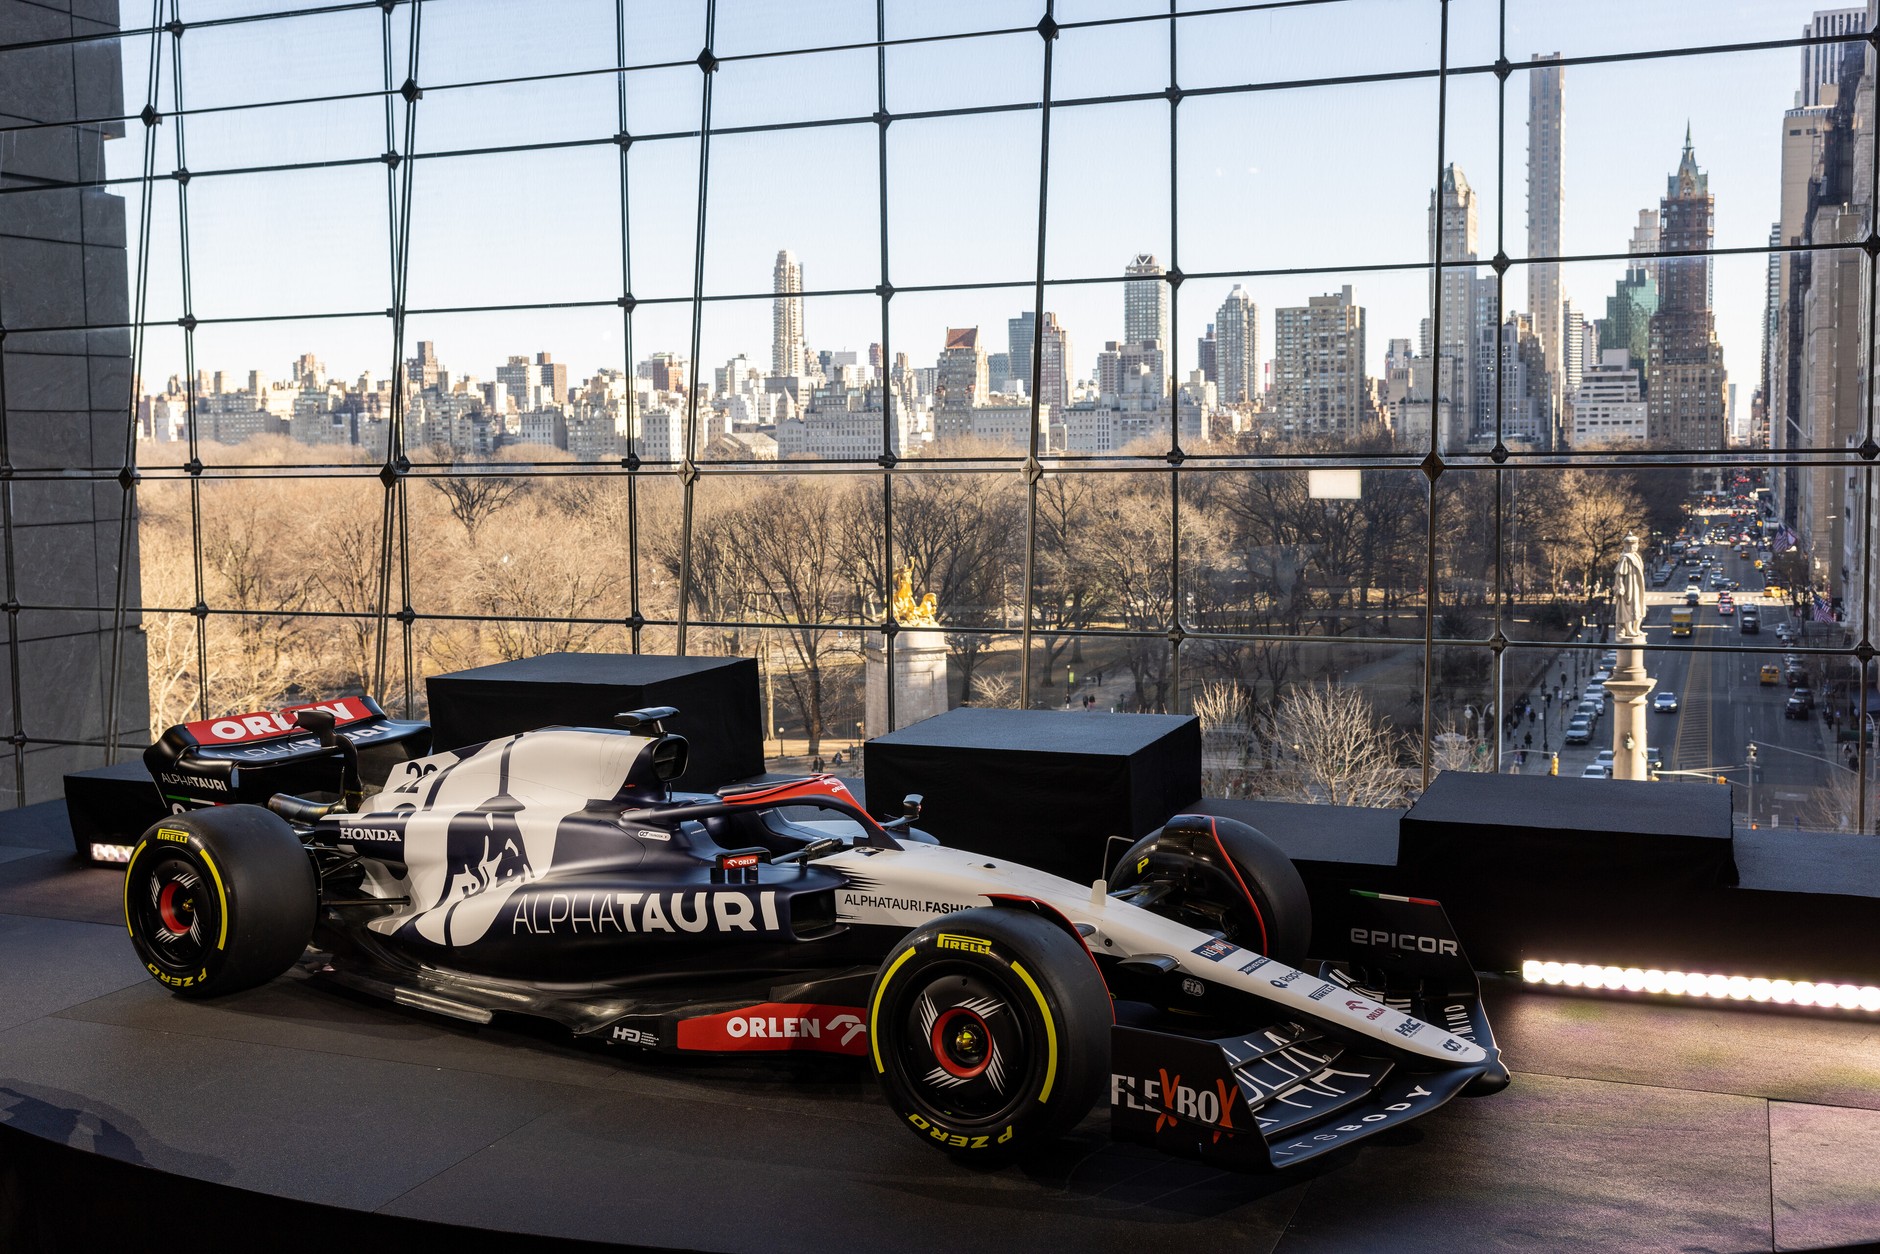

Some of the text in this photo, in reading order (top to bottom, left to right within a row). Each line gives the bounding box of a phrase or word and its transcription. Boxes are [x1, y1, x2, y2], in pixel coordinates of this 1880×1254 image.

[211, 702, 355, 740] ORLN
[161, 772, 228, 792] ALPHATAURI
[156, 828, 190, 844] PIRELLI
[340, 827, 402, 842] HONDA
[738, 857, 757, 866] ORLEN
[512, 891, 780, 935] ALPHATAURI
[937, 933, 992, 955] PIRELLI
[147, 962, 195, 988] ZERO
[1184, 980, 1203, 994] FIA
[1308, 982, 1337, 1001] PIRELLI
[1365, 1007, 1387, 1021] ORLEN
[726, 1016, 821, 1039] ORLEN
[908, 1113, 990, 1149] ZERO
